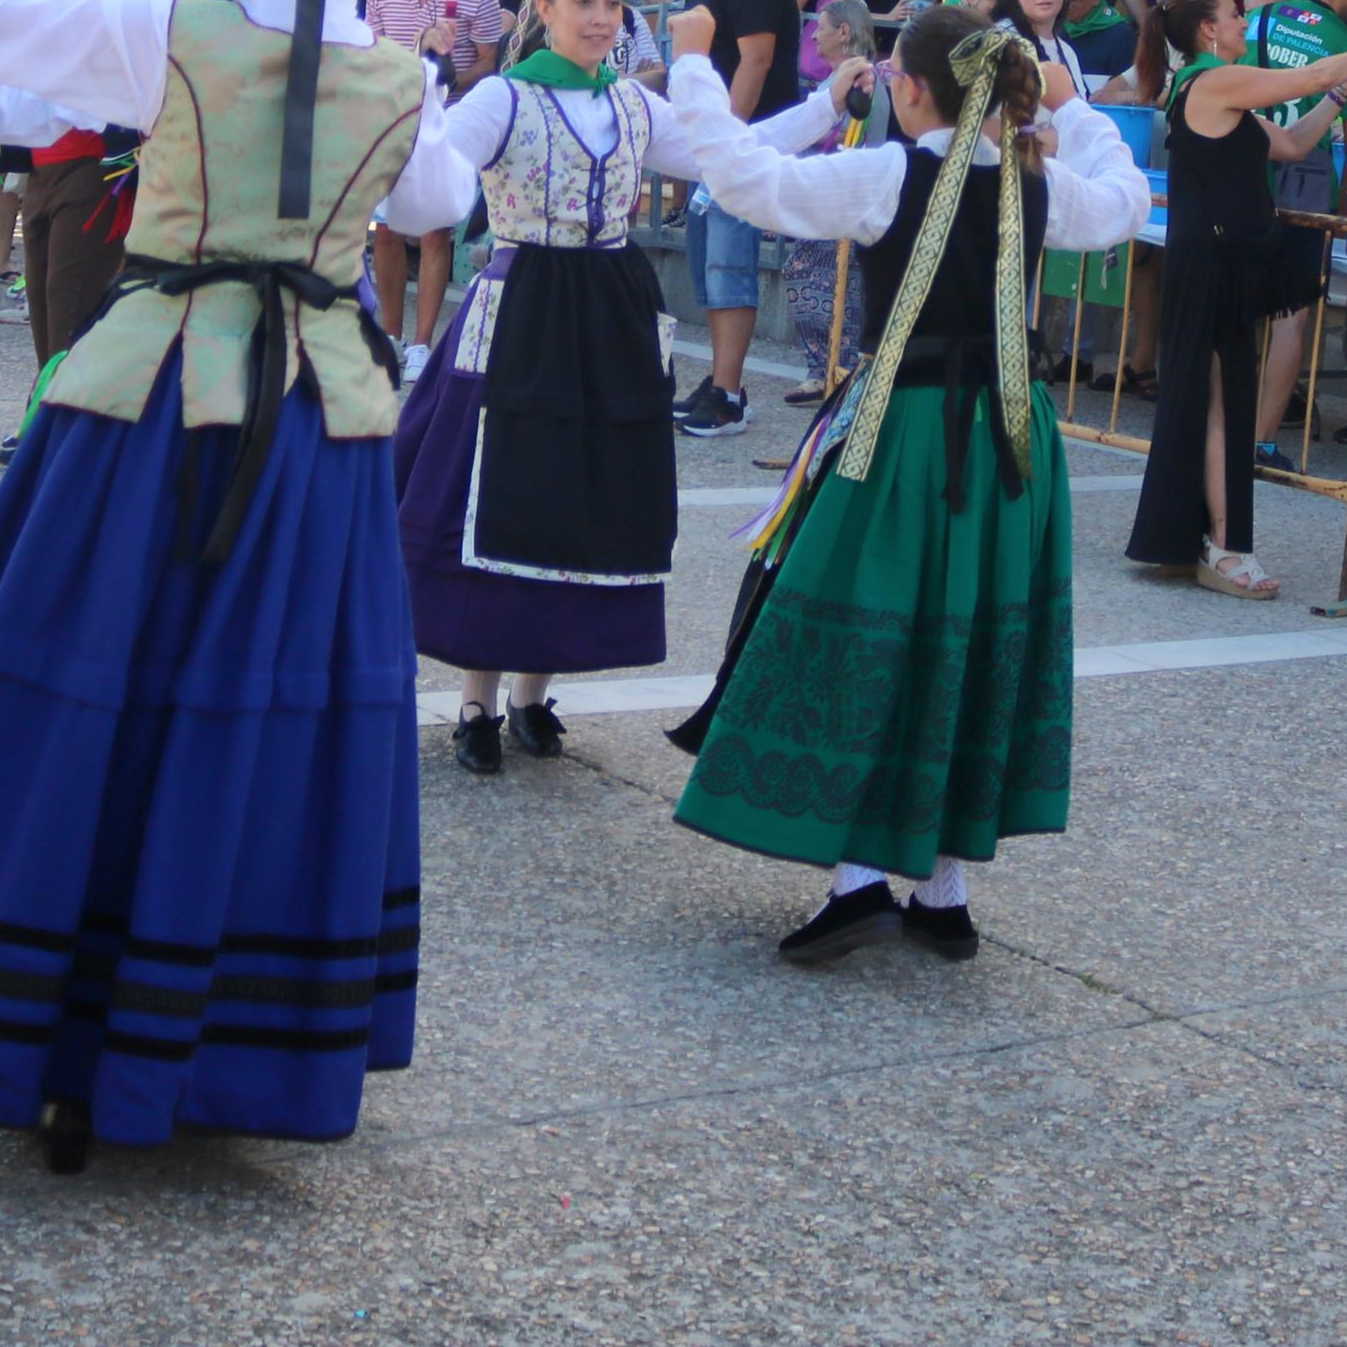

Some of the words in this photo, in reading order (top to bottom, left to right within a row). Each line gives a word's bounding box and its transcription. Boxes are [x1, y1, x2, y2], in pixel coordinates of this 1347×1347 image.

[1272, 32, 1286, 43] DE
[1286, 35, 1330, 57] PALENCIA
[1275, 23, 1323, 45] Diputación
